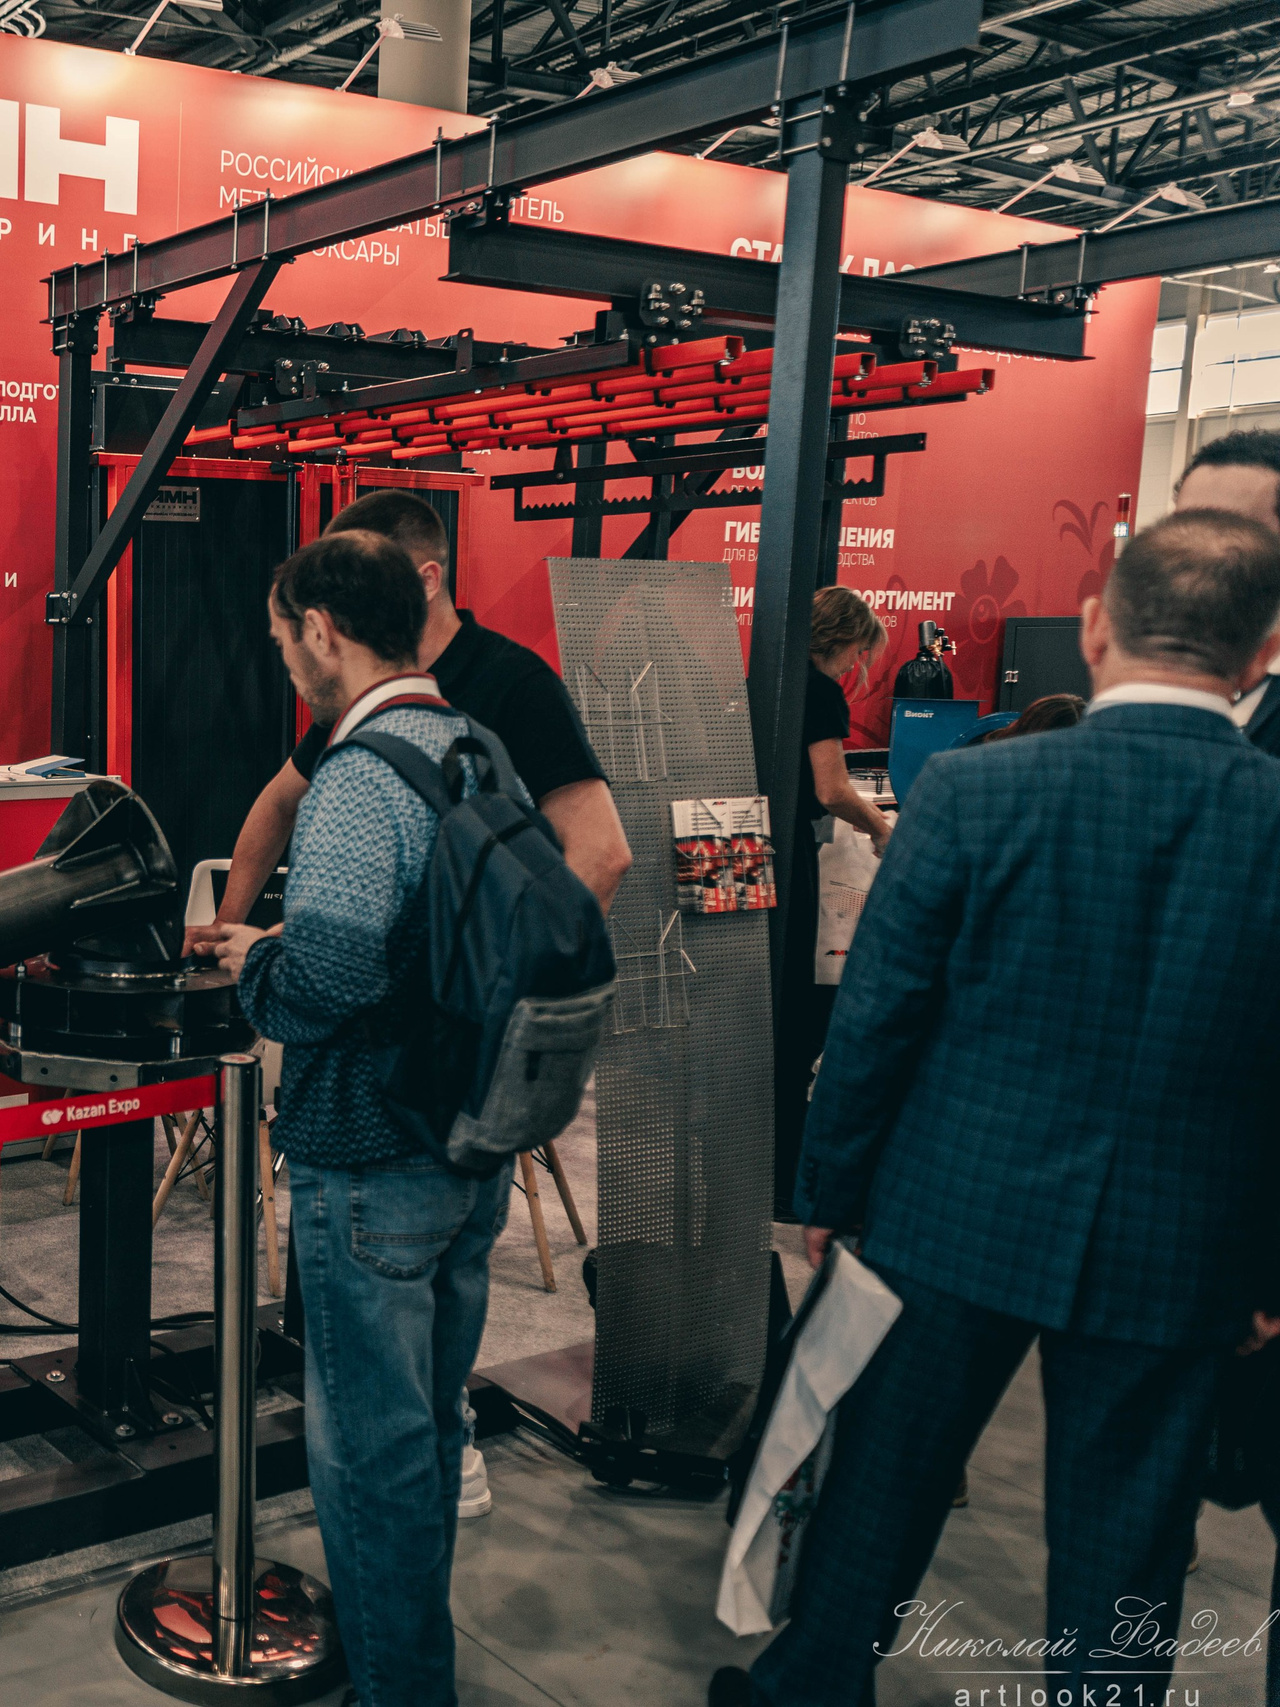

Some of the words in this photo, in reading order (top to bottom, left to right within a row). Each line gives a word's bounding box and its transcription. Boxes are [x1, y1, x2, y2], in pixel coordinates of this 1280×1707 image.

[722, 548, 746, 563] ДЛЯ
[5, 572, 18, 588] И
[66, 1105, 106, 1122] Kazan
[109, 1097, 140, 1115] Expo
